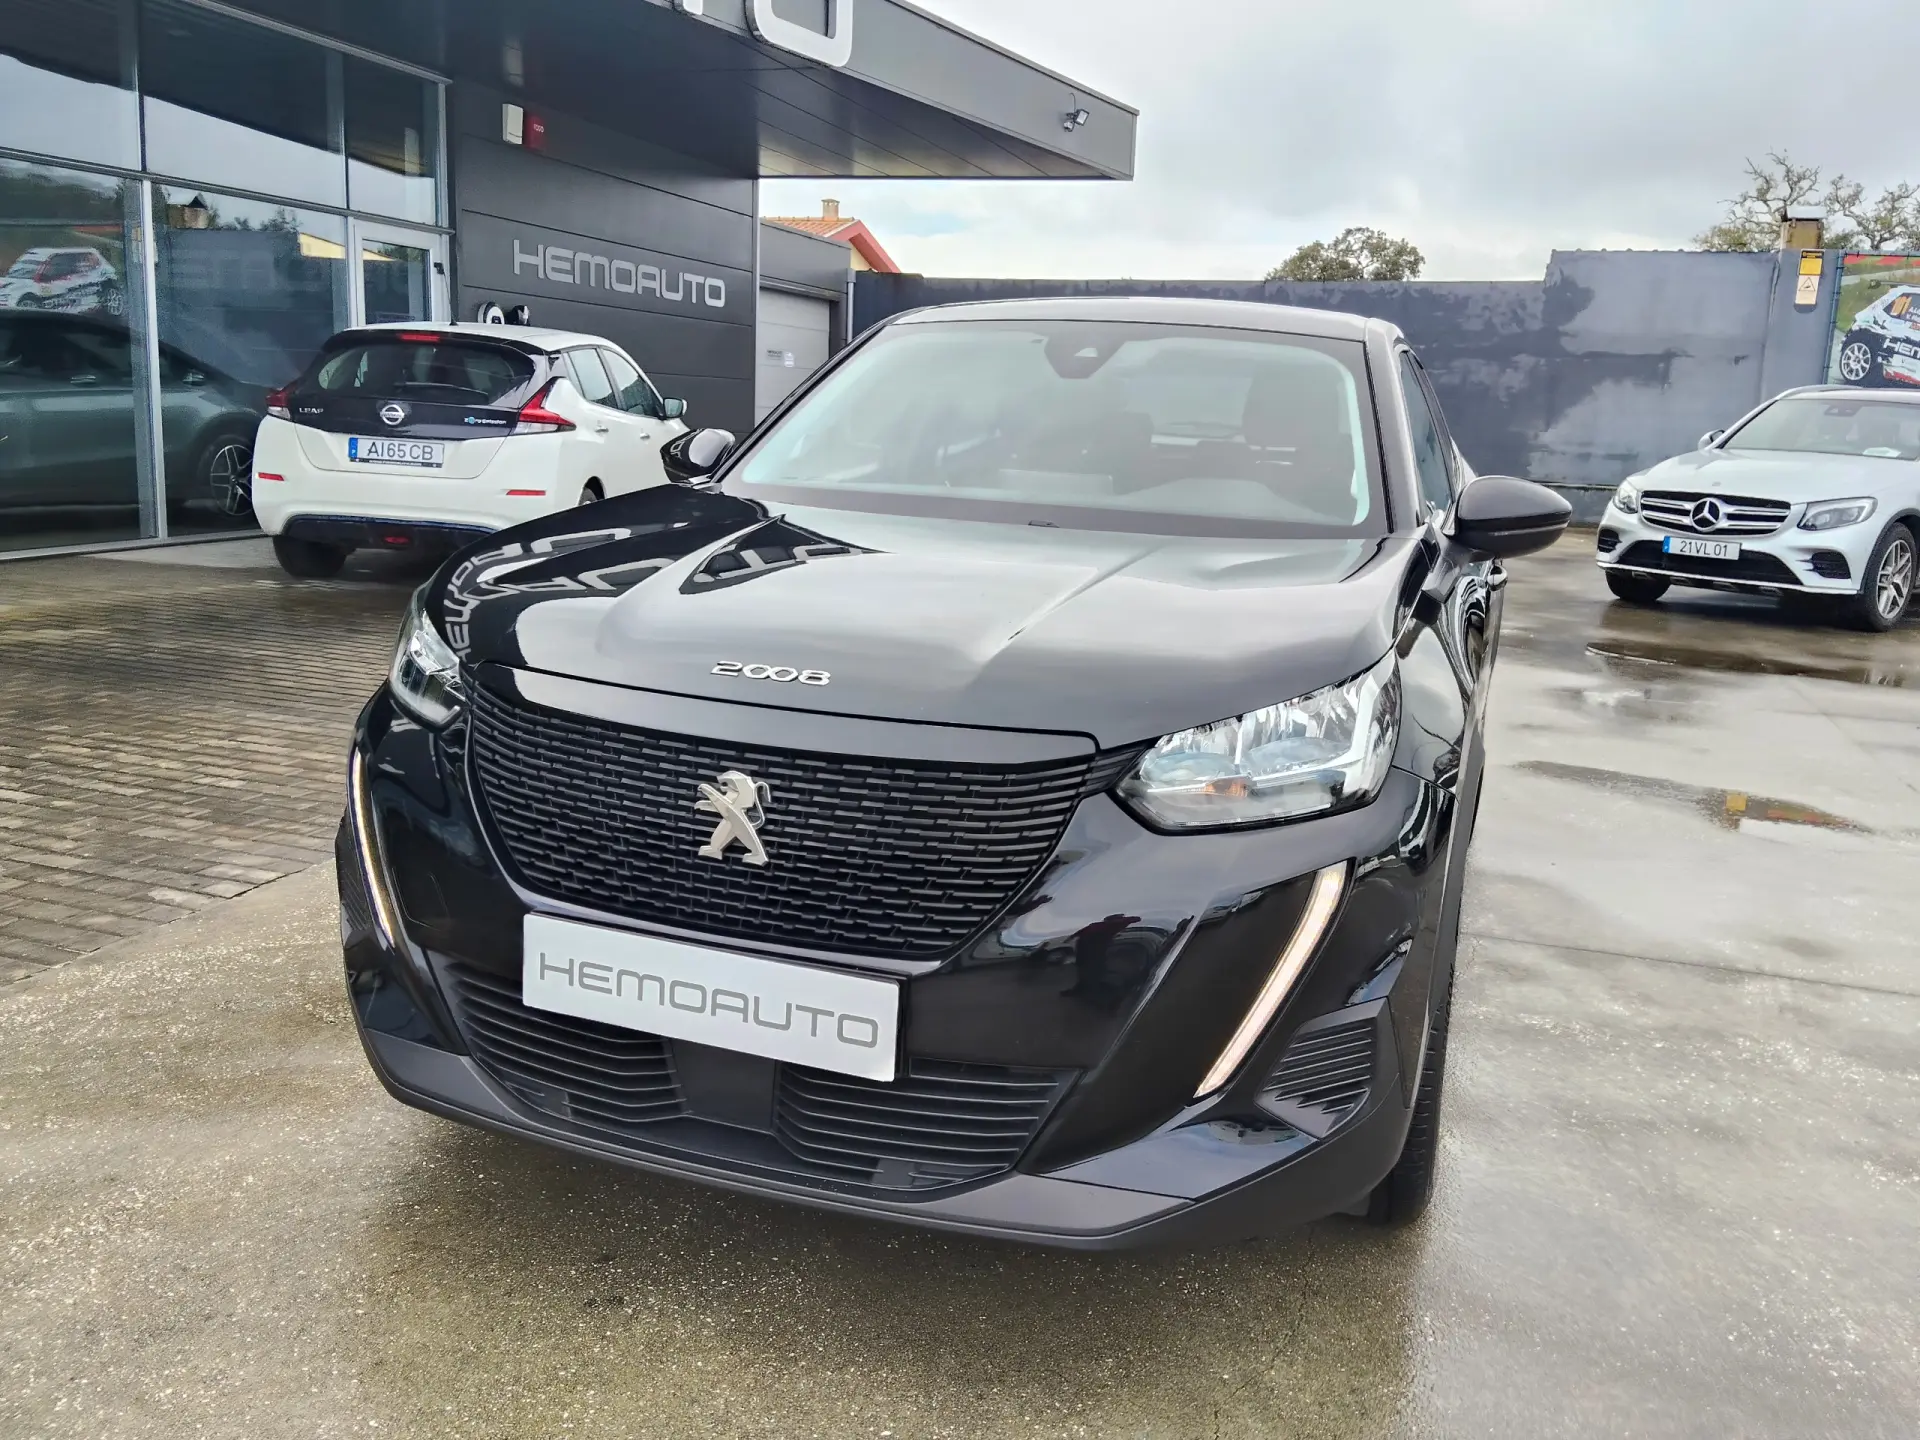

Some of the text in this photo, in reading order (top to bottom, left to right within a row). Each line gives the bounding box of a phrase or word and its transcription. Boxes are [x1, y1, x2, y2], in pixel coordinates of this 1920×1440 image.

[513, 239, 726, 308] HEMOAUTO
[710, 660, 831, 686] 2008
[539, 952, 878, 1049] HEMOAUTO
